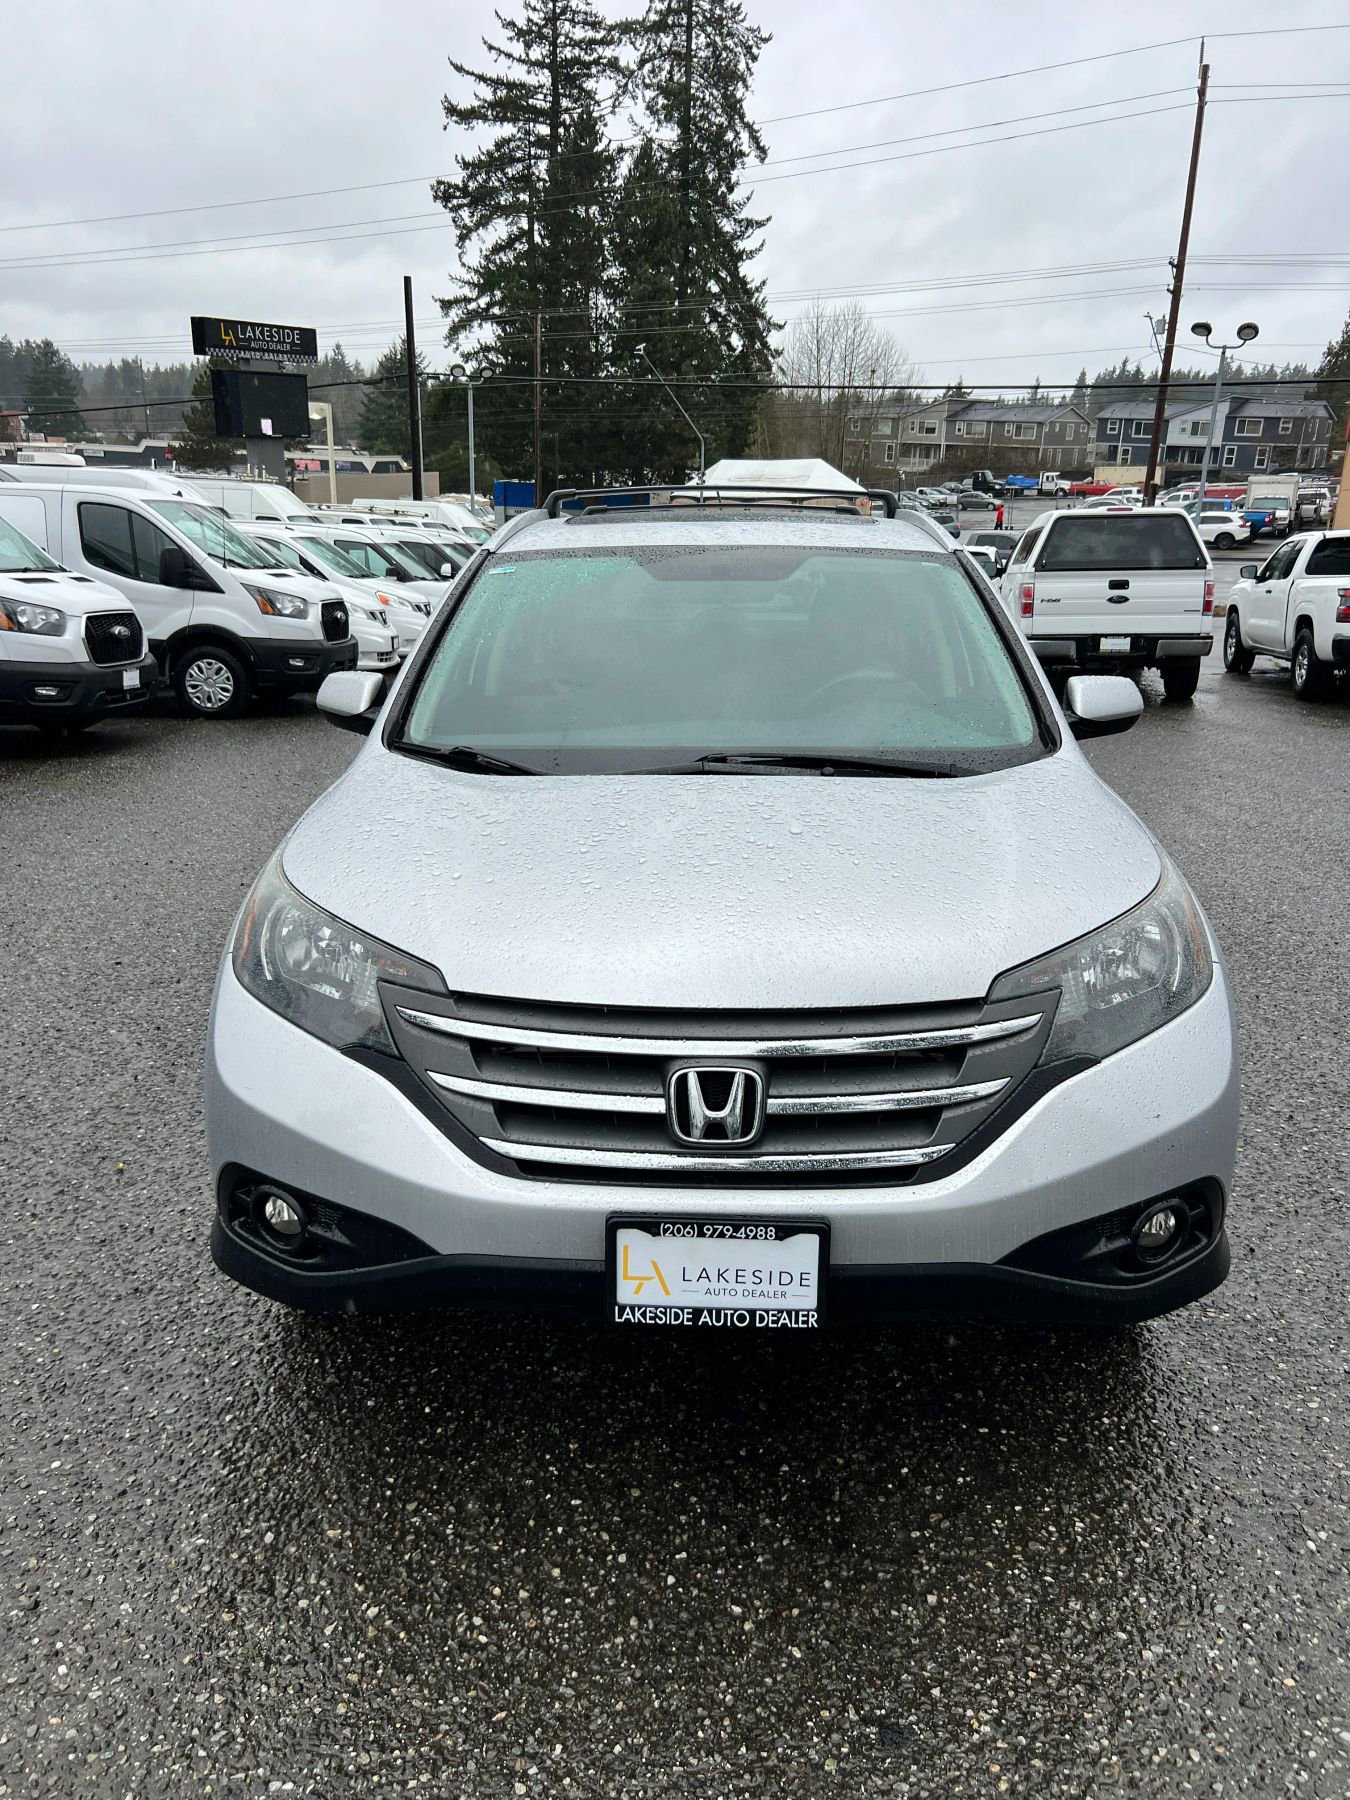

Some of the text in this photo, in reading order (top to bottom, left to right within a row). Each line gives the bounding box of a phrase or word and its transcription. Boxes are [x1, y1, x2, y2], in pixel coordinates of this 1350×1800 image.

[238, 325, 301, 343] LAKESIDE
[250, 341, 291, 351] AUTO DEALER
[240, 351, 288, 361] AUTO SALES
[659, 1222, 776, 1240] (206) 979-4988
[681, 1266, 811, 1288] LAKESIDE
[704, 1288, 787, 1300] AUTO DEALER
[614, 1305, 818, 1328] LAKESIDE AUTO DEALER
